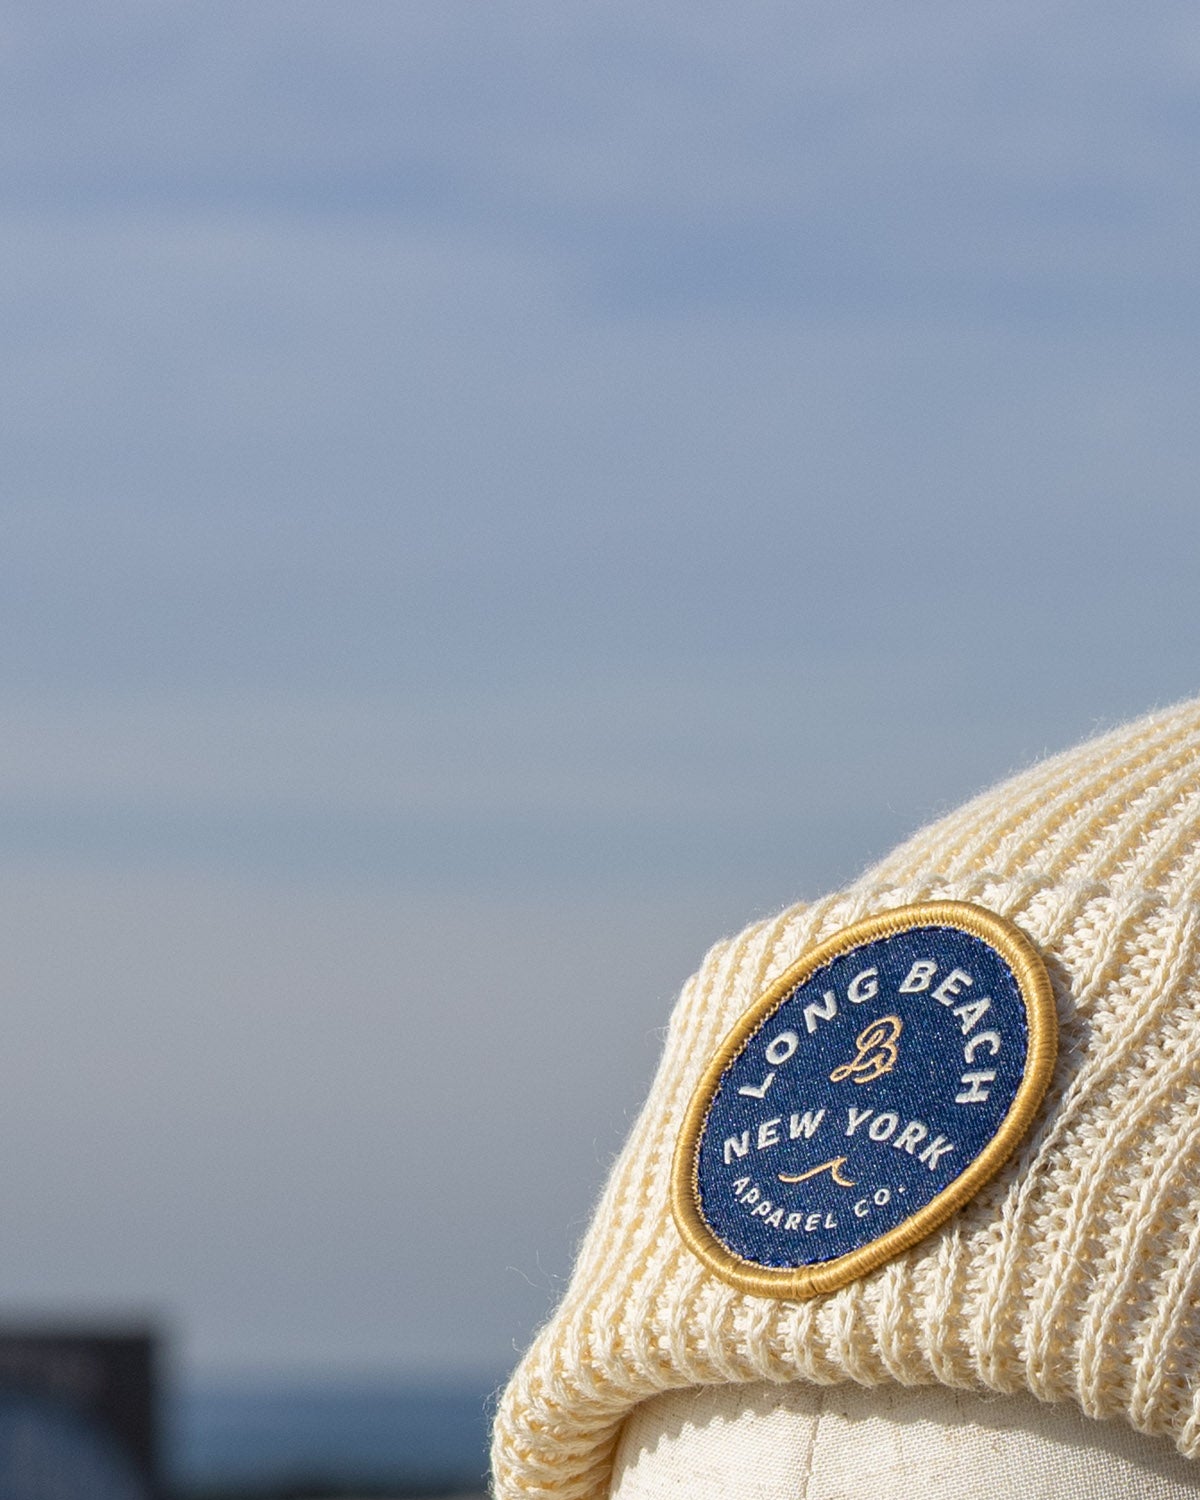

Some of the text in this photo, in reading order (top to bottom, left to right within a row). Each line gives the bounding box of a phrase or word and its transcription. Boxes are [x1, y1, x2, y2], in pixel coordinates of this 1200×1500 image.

[738, 960, 999, 1104] LONG BEACH
[723, 1108, 954, 1171] NEW YORK
[732, 1176, 906, 1232] APPAREL CO.
